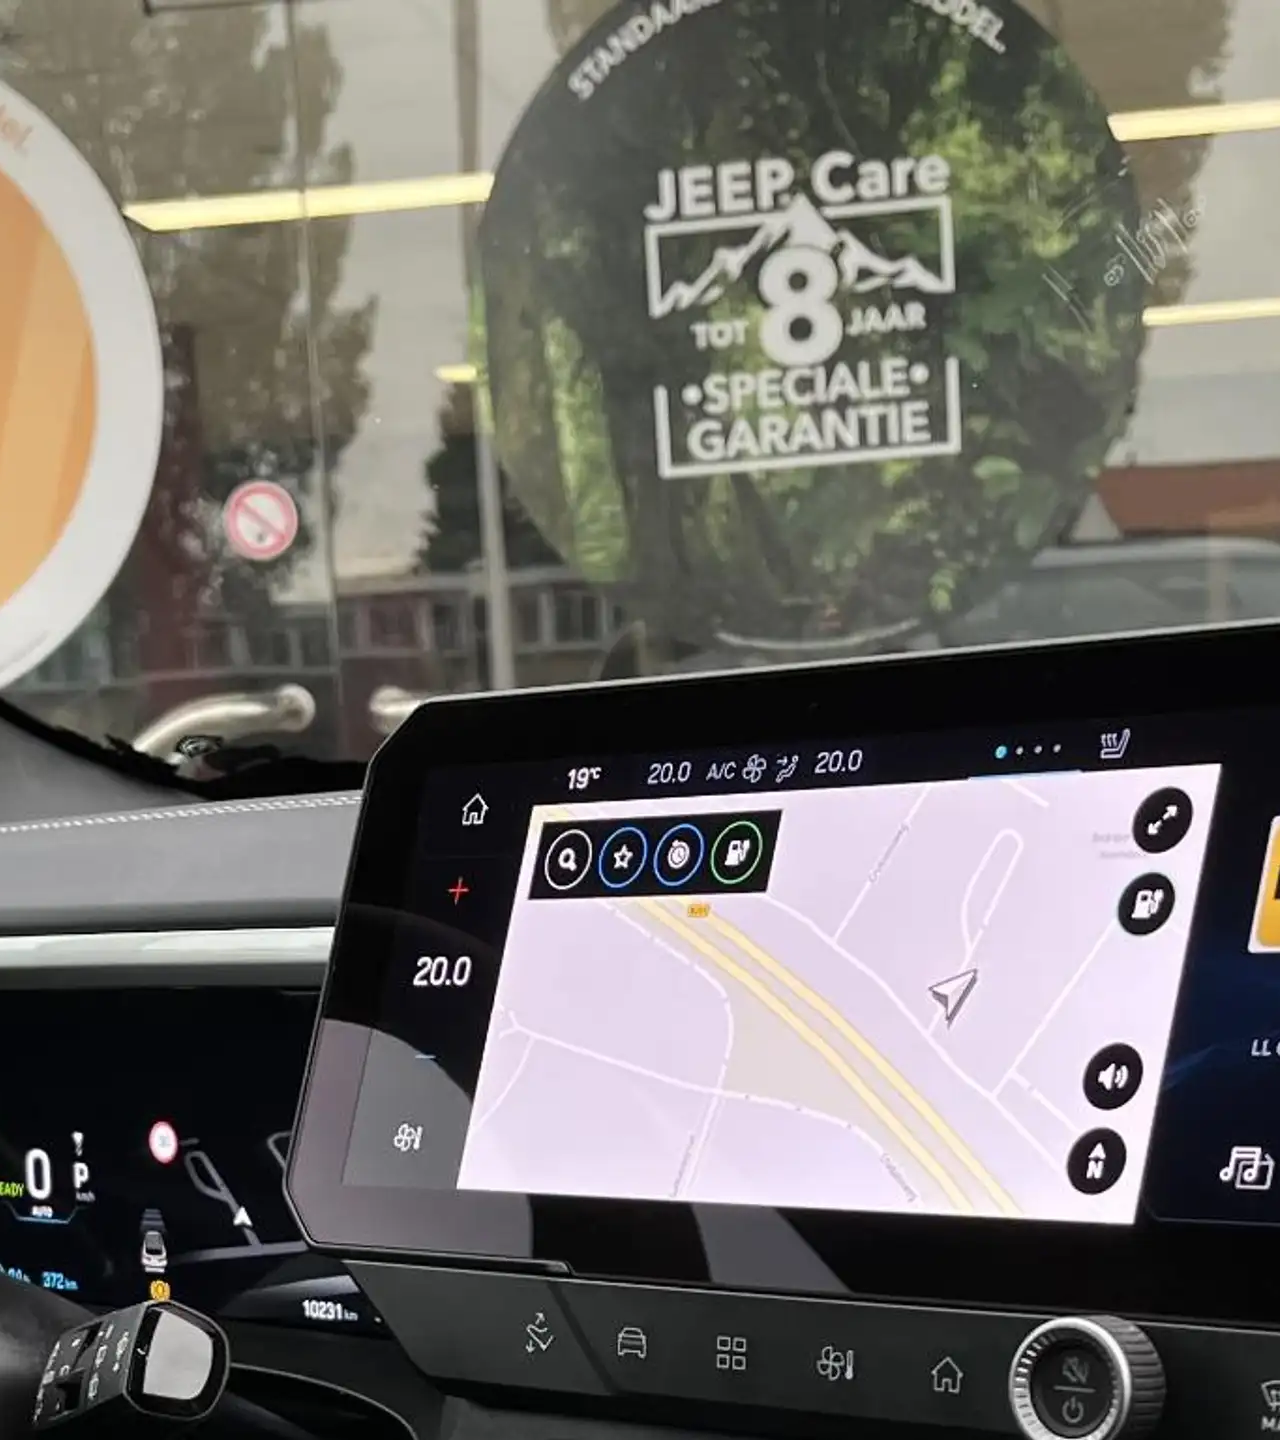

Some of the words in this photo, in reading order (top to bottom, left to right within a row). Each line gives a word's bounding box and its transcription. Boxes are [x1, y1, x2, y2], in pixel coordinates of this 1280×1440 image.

[810, 150, 951, 205] Care
[690, 318, 750, 350] TOT
[758, 246, 844, 368] 8
[846, 301, 927, 337] JAAR
[686, 398, 933, 463] GARANTIE
[647, 761, 693, 785] 20.0
[705, 763, 737, 782] A/C
[814, 749, 864, 775] 20.0
[412, 955, 473, 987] 20.0
[1250, 1039, 1272, 1058] LL
[25, 1148, 52, 1200] 0
[73, 1161, 89, 1189] P
